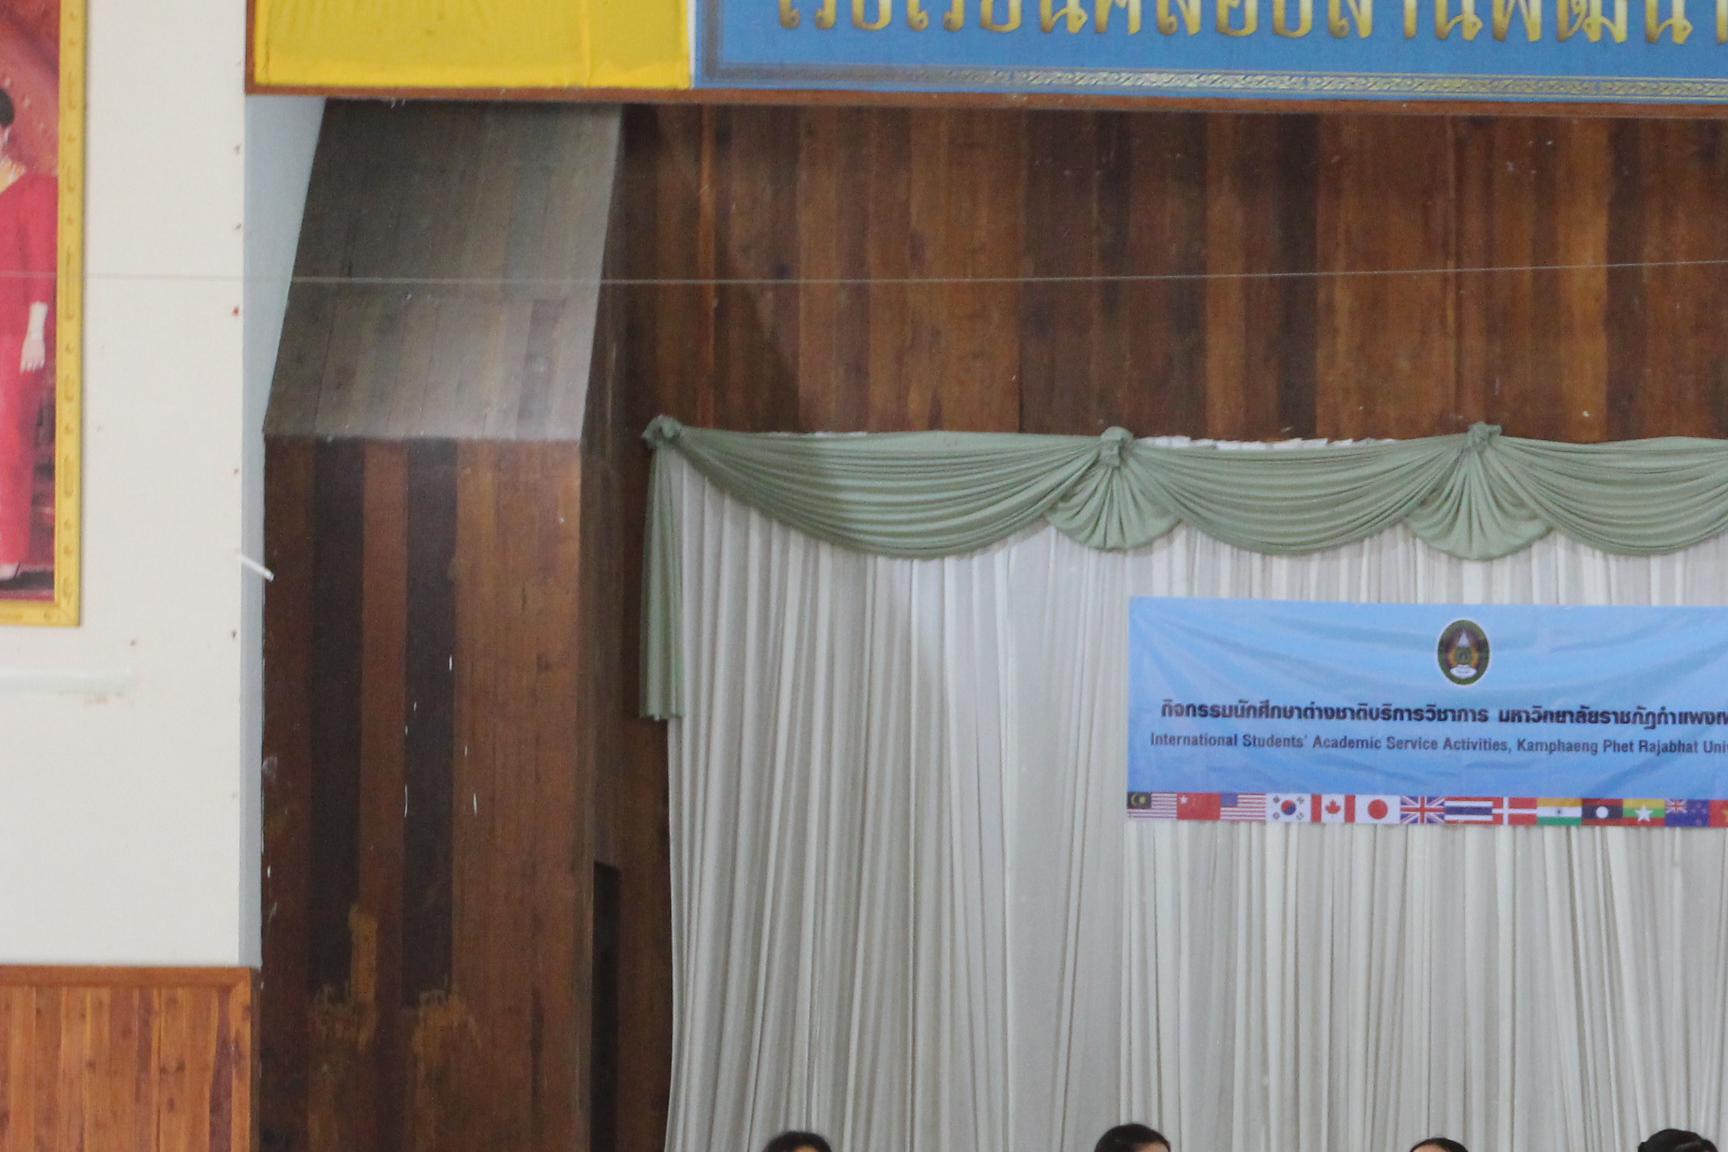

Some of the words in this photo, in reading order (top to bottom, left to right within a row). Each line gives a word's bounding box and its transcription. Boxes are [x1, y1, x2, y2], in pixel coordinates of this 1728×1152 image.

[1151, 732, 1238, 747] International
[1312, 735, 1382, 750] Academic
[1386, 736, 1438, 751] Service
[1443, 737, 1512, 753] Activities,
[1517, 738, 1599, 756] Kamphaeng
[1603, 739, 1634, 753] Phet
[1638, 740, 1699, 756] Rajabhat
